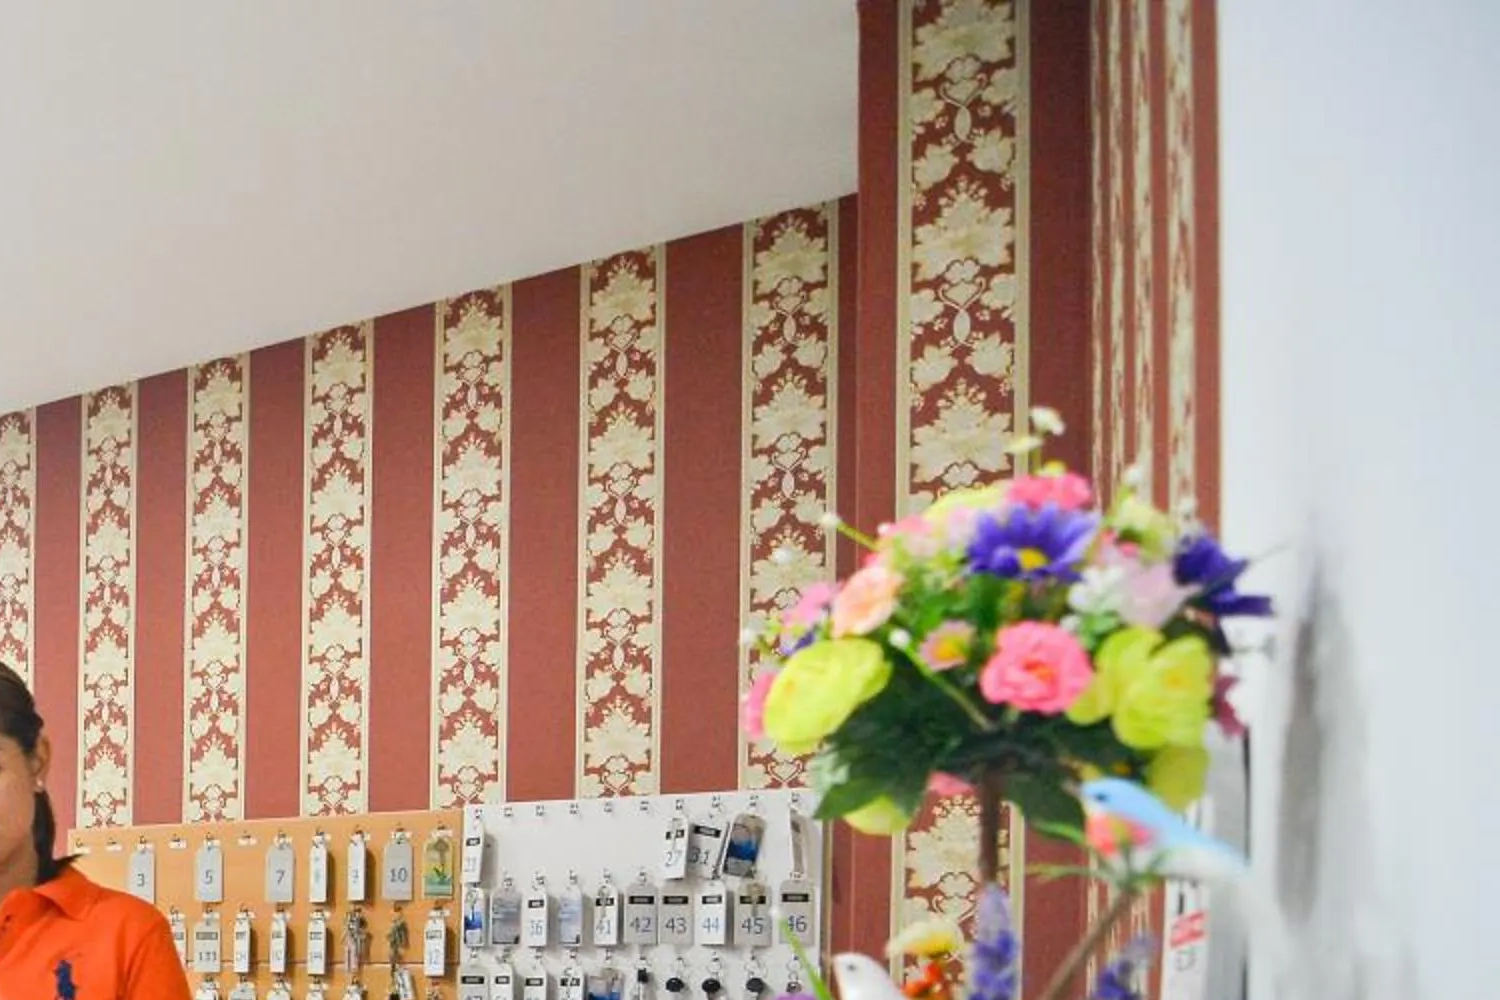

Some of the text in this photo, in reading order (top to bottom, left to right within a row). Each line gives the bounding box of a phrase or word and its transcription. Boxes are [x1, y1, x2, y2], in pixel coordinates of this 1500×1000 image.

[204, 870, 213, 885] 5
[276, 870, 285, 885] 7
[389, 867, 408, 883] 10
[629, 917, 652, 933] 42
[665, 917, 687, 934] 43
[701, 917, 719, 934] 44
[741, 917, 764, 936] 45
